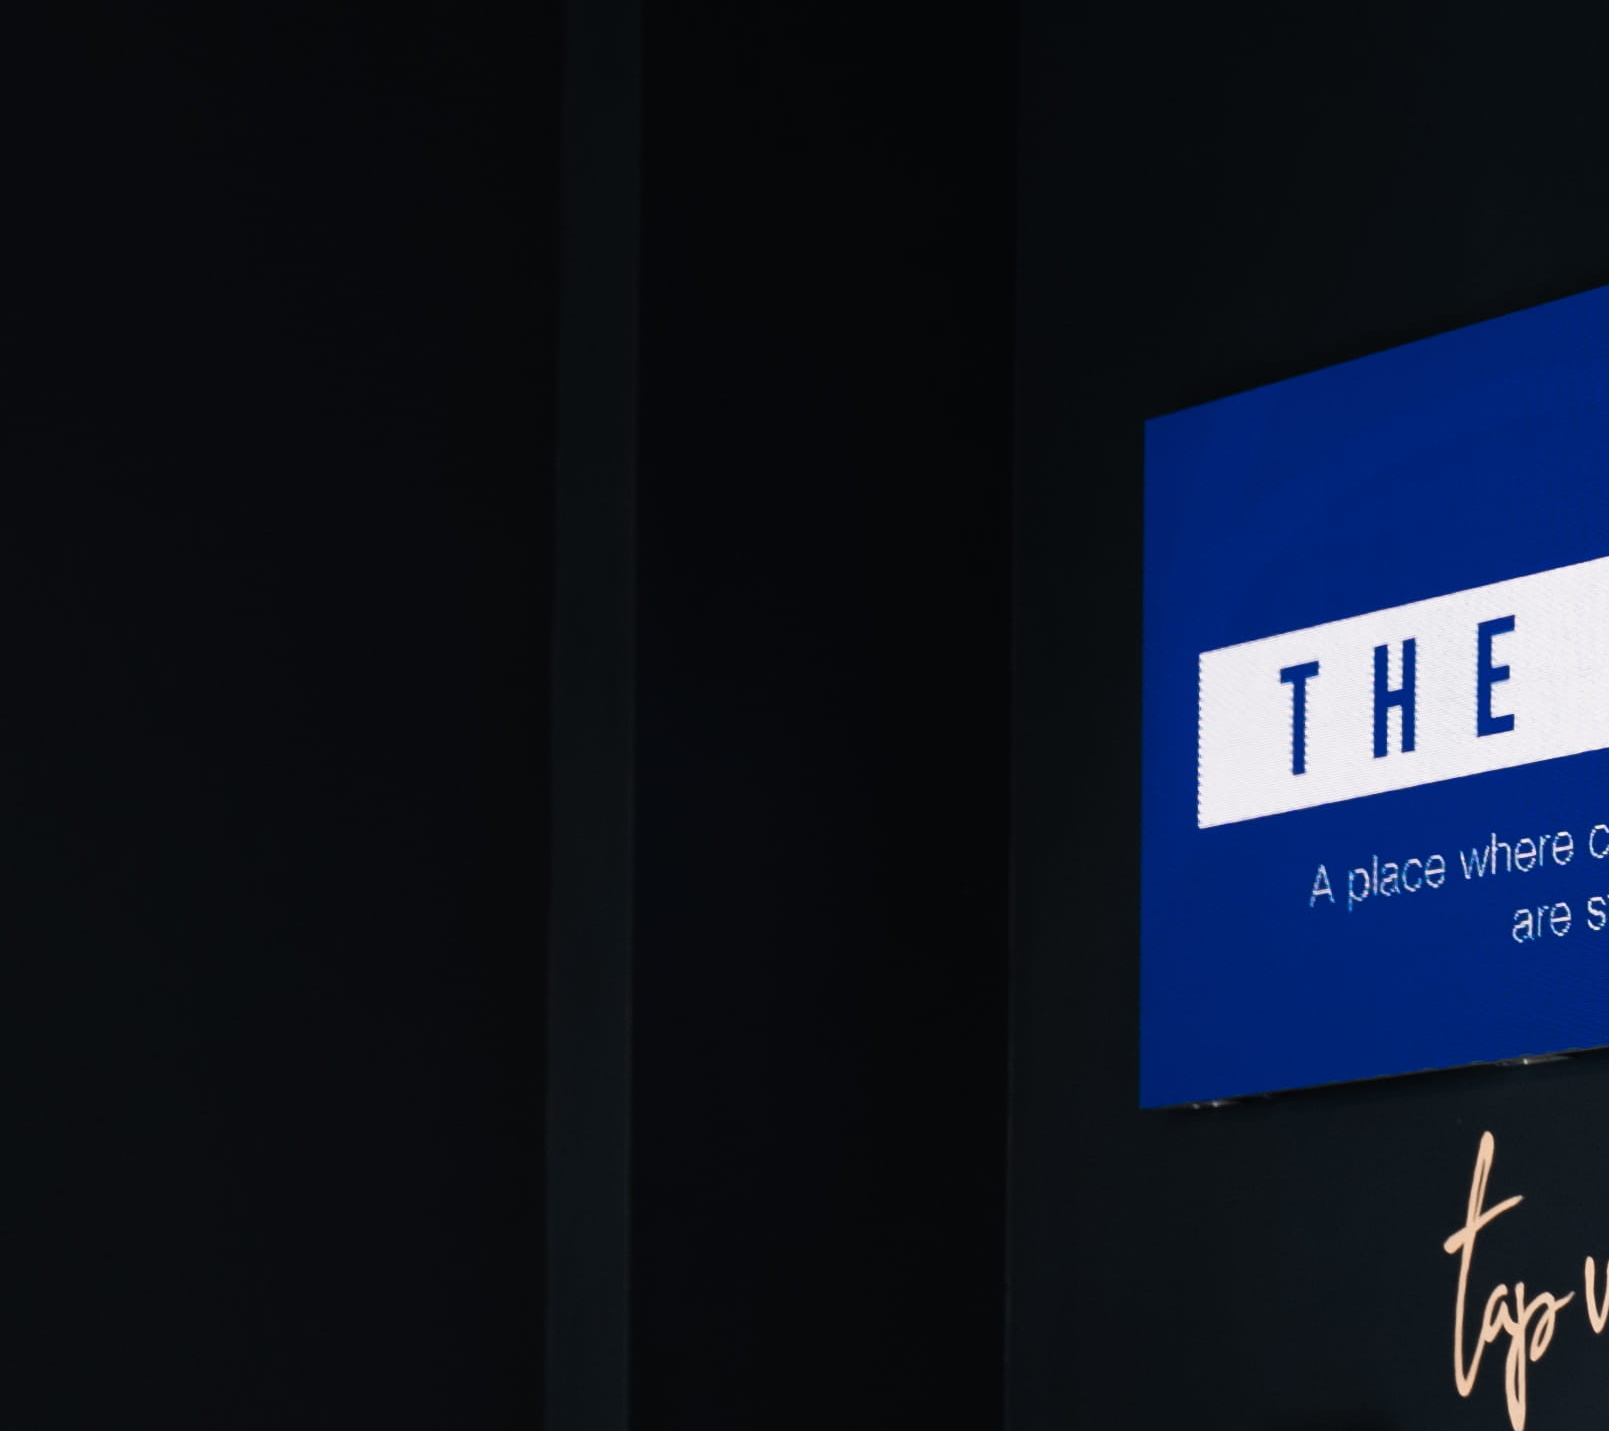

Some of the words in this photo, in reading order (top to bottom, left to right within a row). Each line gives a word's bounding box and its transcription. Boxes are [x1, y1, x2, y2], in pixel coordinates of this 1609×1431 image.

[1279, 614, 1517, 776] THE
[1308, 863, 1335, 908] A
[1346, 853, 1447, 912] place
[1459, 832, 1575, 880] where
[1511, 896, 1572, 944] are
